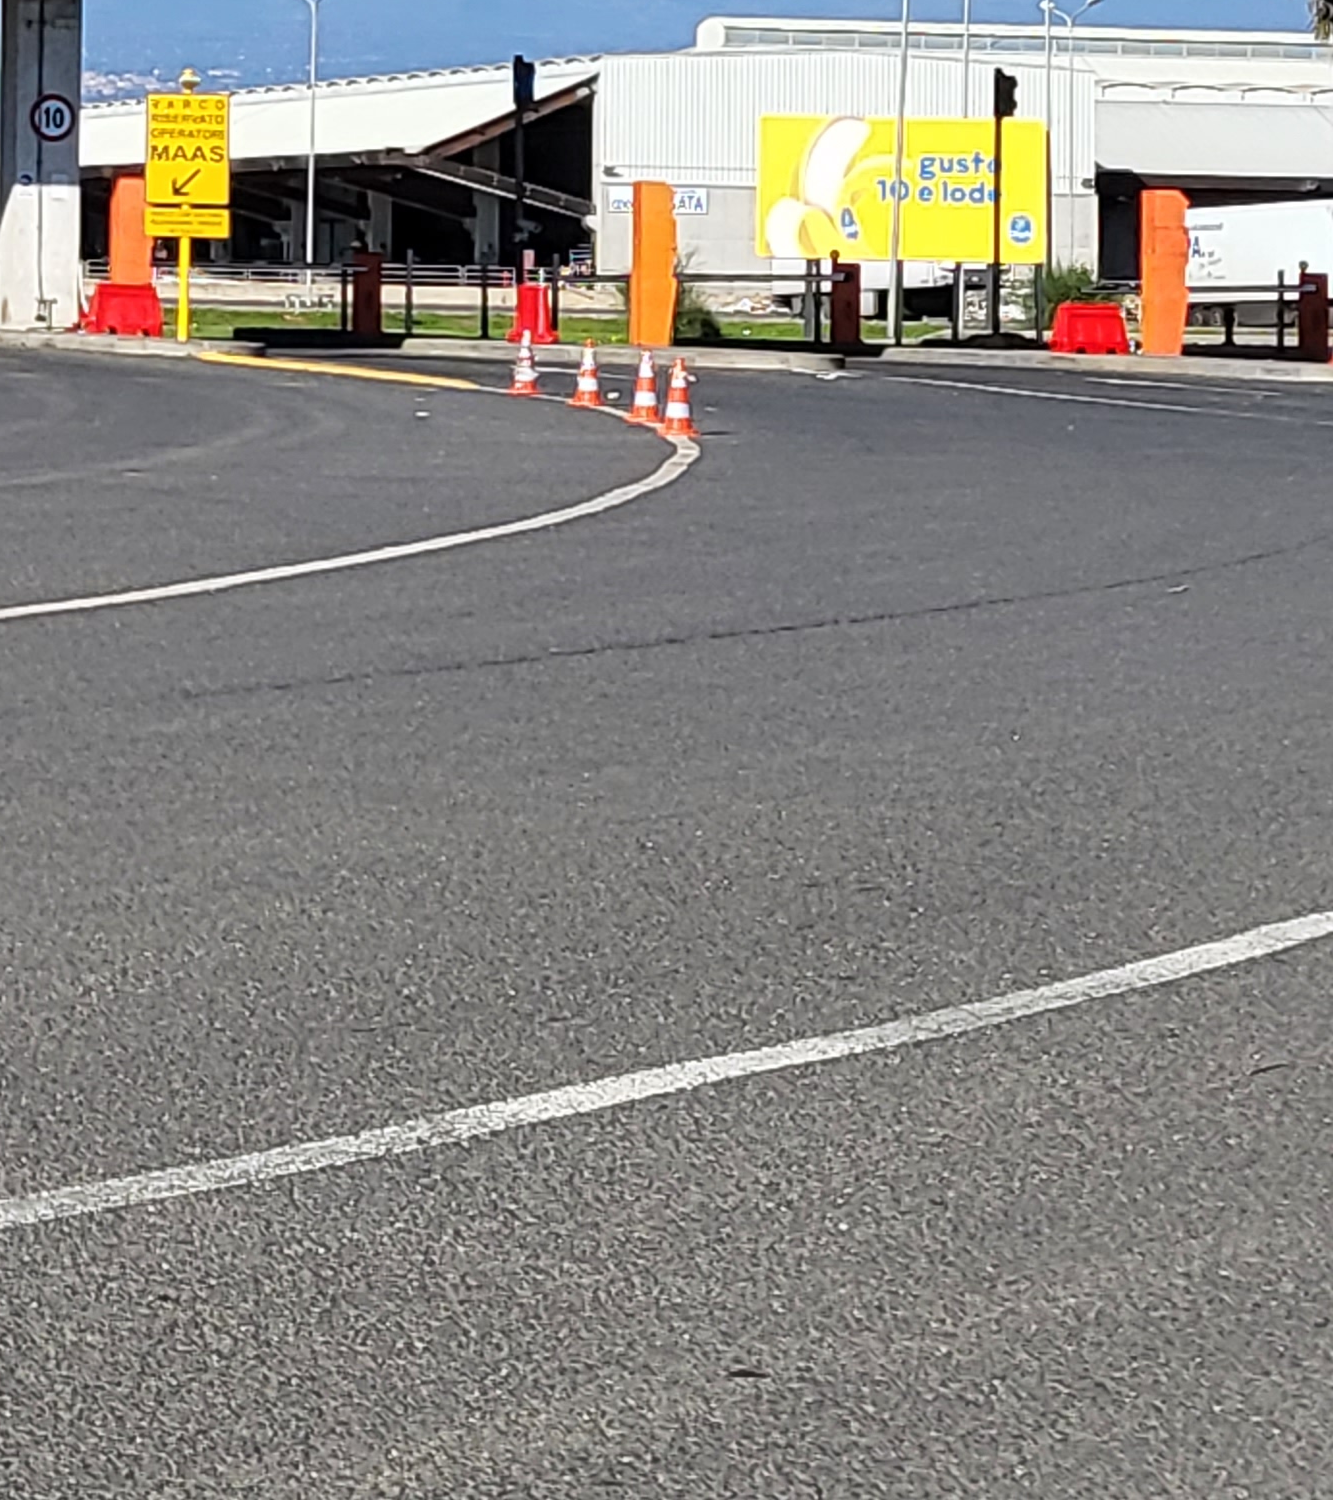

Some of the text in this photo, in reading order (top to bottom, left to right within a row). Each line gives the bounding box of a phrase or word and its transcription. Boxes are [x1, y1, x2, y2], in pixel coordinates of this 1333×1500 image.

[44, 107, 65, 129] 10
[150, 145, 225, 162] MAAS
[877, 179, 910, 202] 10
[918, 186, 933, 202] e
